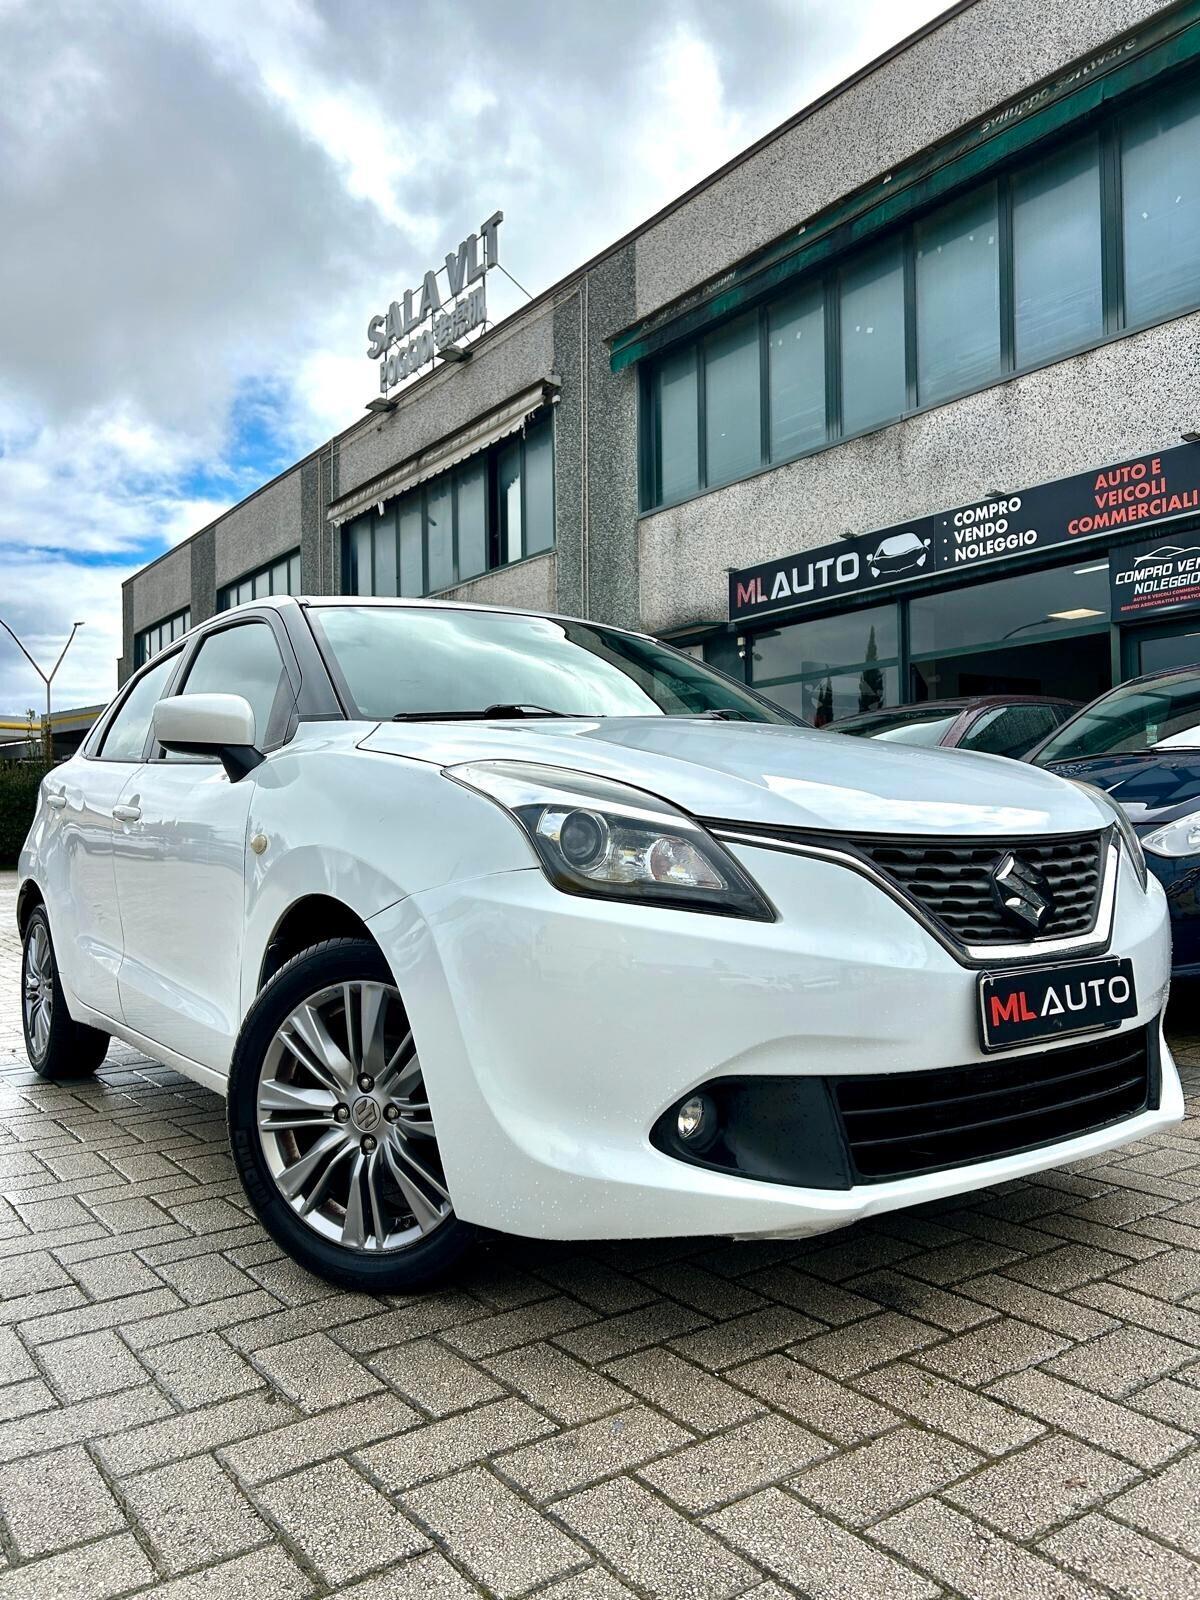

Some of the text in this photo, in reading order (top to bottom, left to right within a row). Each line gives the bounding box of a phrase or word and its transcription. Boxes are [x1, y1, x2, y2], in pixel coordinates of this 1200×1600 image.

[367, 210, 503, 360] SALA VLT
[1094, 458, 1161, 491] AUTO E
[1094, 477, 1167, 509] VEICOLI
[954, 497, 1022, 527] COMPRO
[1067, 489, 1199, 535] COMMERCIALI
[954, 518, 1009, 544] VENDO
[954, 530, 1038, 562] NOLEGGIO
[736, 552, 860, 608] ML AUTO
[1115, 563, 1174, 585] COMPRO
[1134, 571, 1200, 595] NOLEGGIO
[990, 975, 1130, 1027] ML AUTO
